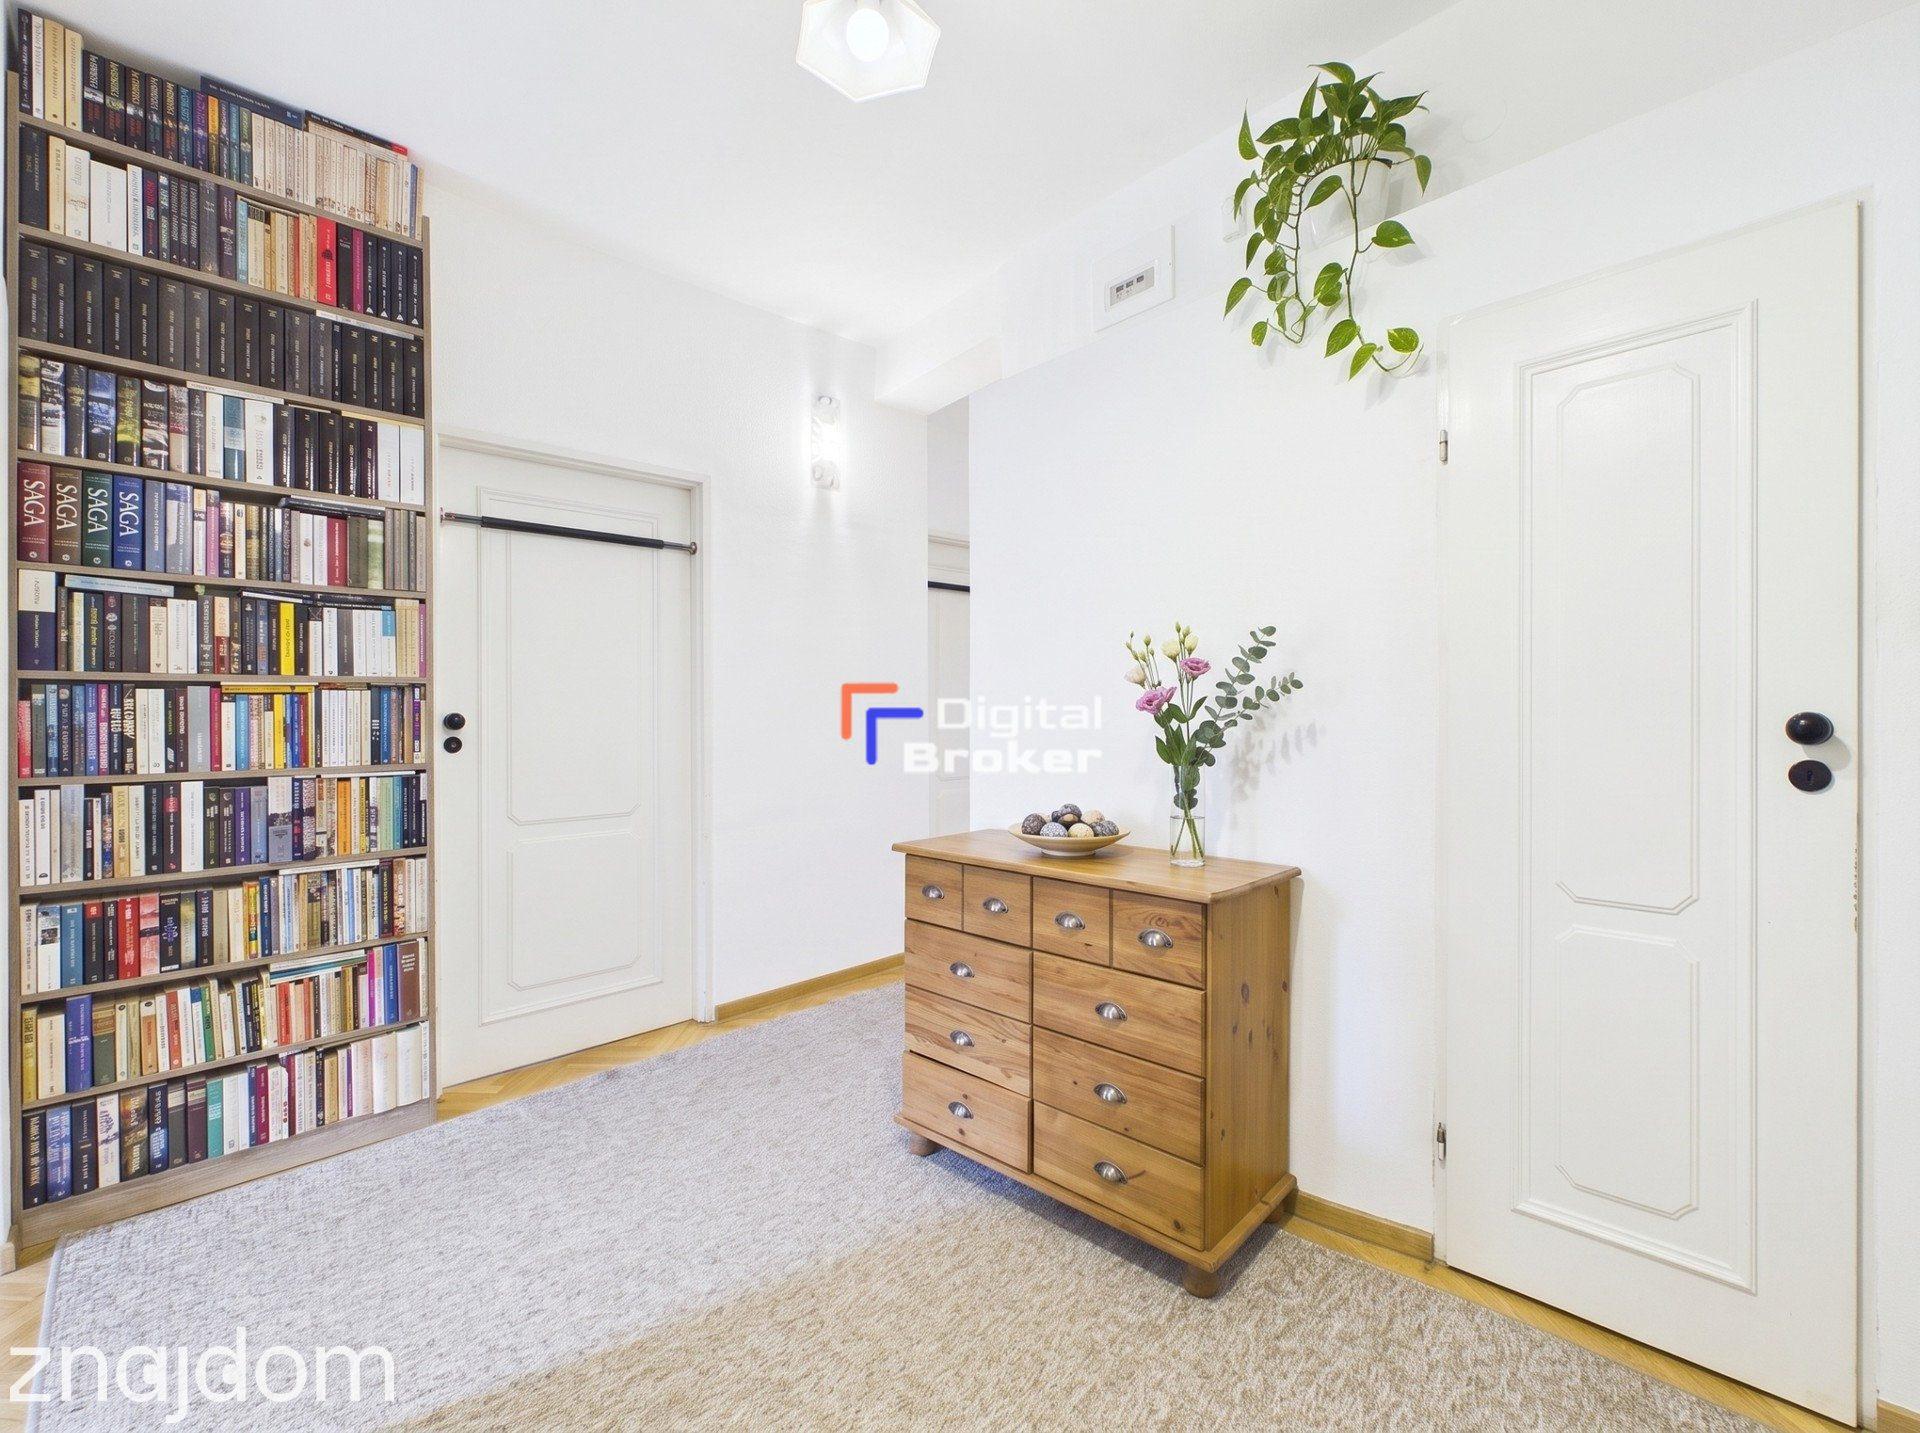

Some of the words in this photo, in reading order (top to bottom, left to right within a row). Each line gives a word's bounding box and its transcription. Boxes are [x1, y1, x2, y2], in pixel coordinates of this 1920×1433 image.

[24, 480, 45, 526] SAGA
[57, 484, 77, 530] SAGA
[88, 488, 108, 533] SAGA
[120, 492, 139, 537] SAGA
